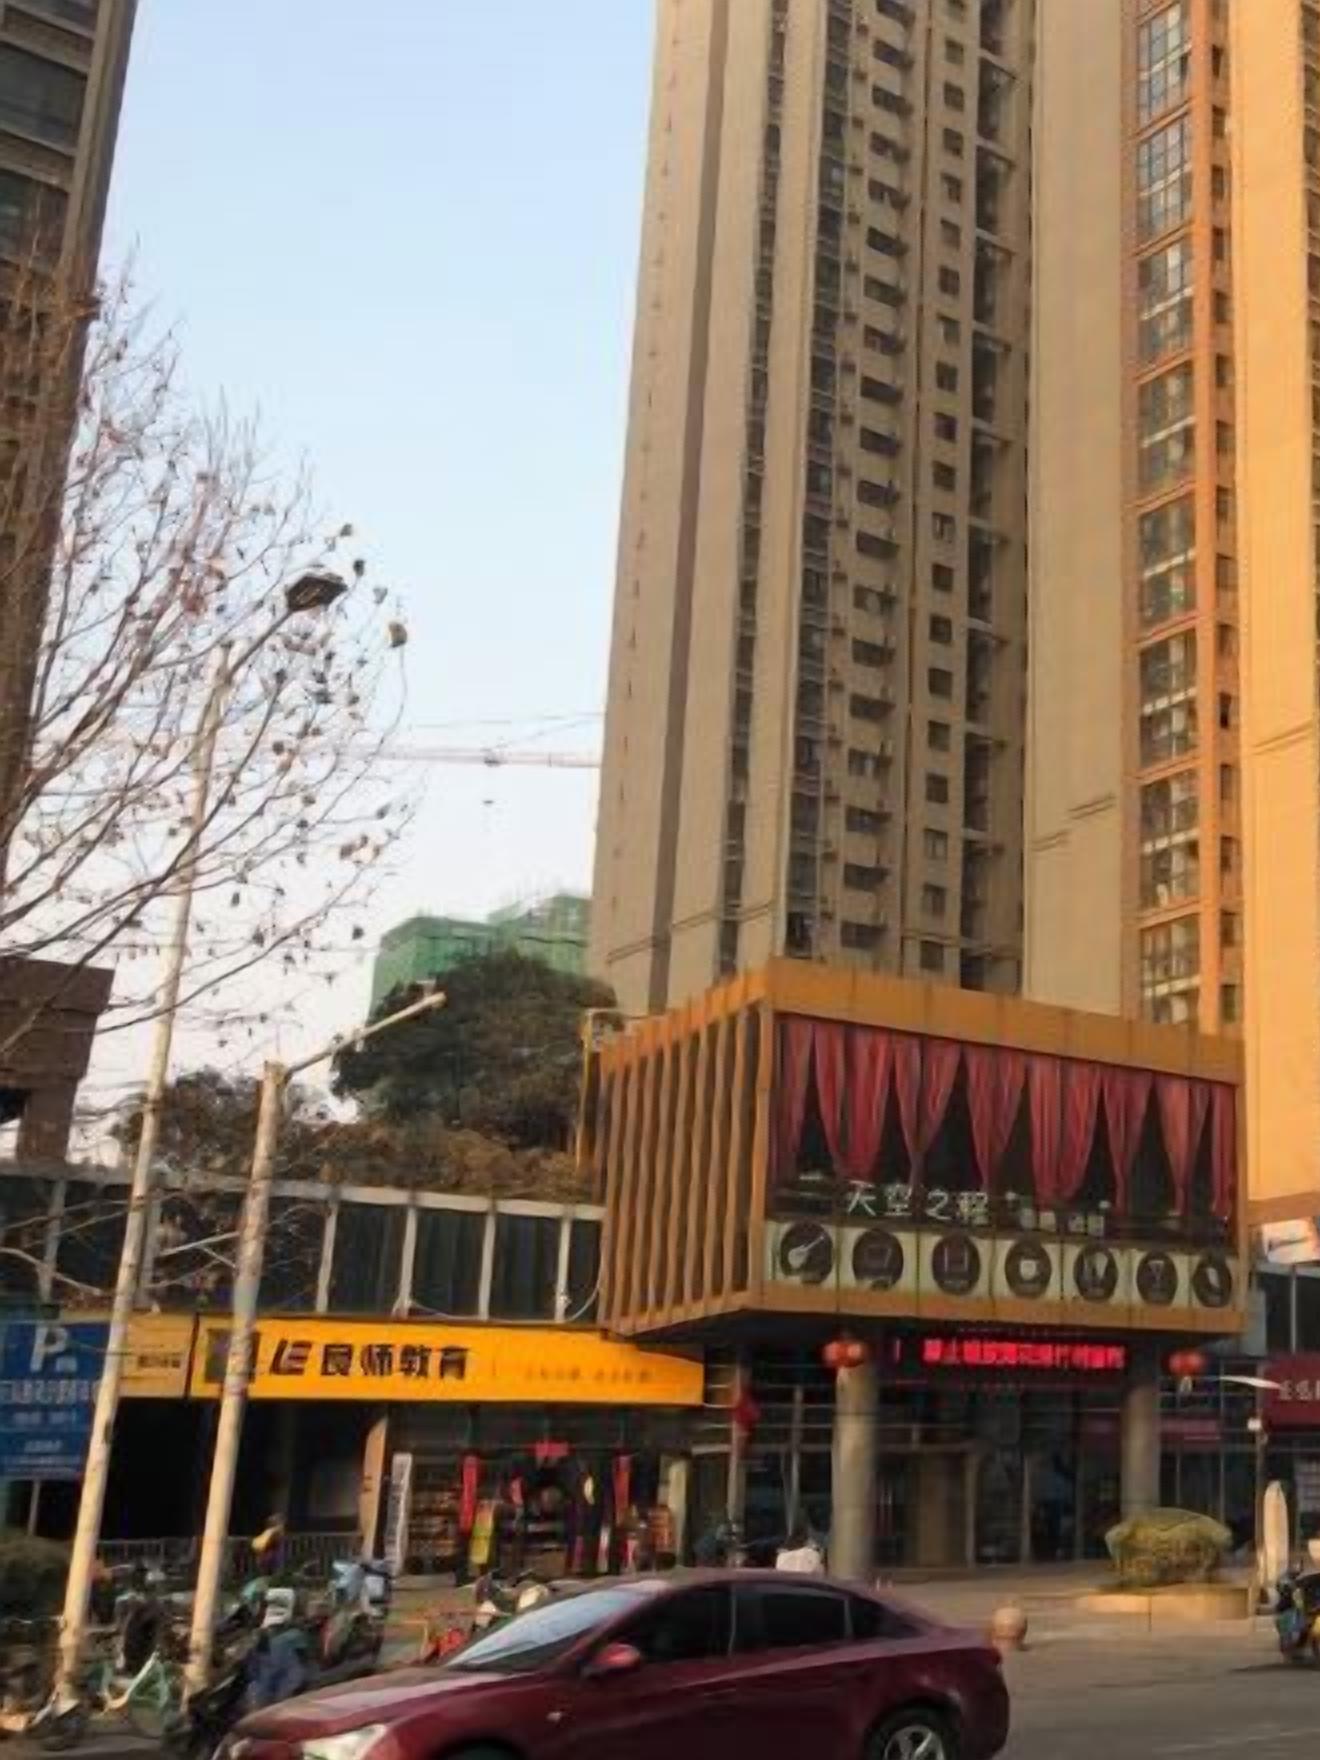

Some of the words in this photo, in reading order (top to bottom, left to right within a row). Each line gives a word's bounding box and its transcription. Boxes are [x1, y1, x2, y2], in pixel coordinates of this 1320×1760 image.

[30, 1327, 68, 1372] P
[320, 1343, 467, 1380] 良师教育
